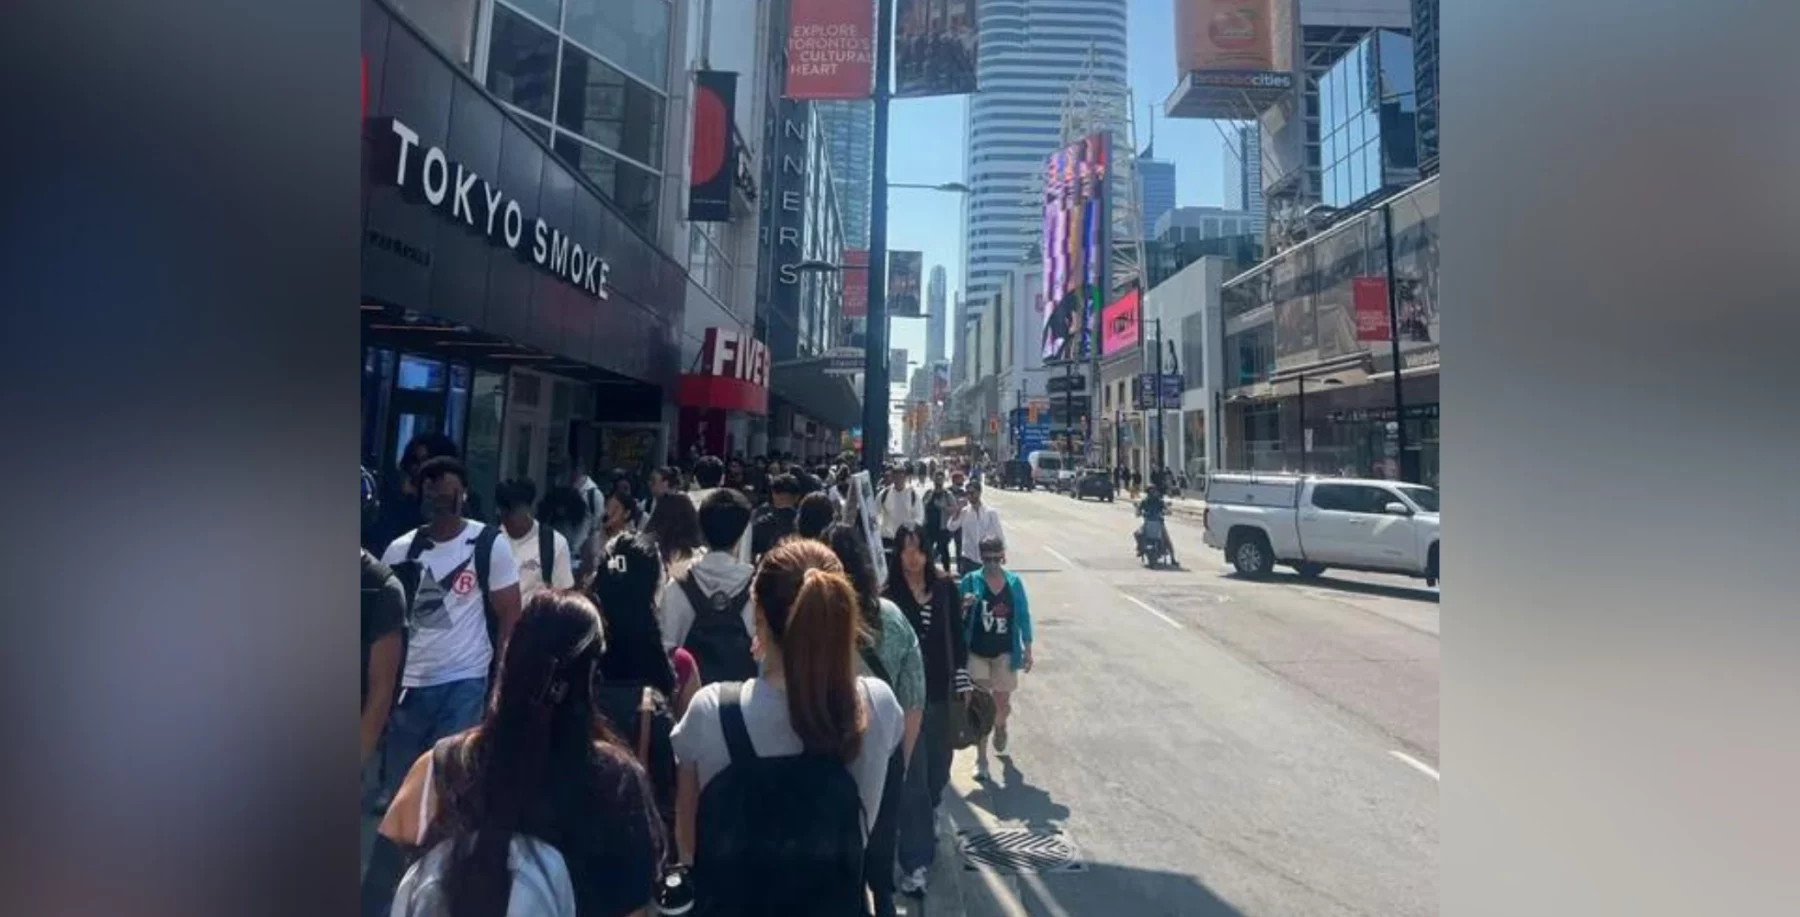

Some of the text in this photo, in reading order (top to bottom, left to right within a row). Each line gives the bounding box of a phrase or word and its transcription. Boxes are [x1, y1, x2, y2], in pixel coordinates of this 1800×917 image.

[793, 23, 857, 37] EXPLORE
[790, 63, 838, 76] HEART
[799, 50, 873, 63] CULTURAL
[392, 118, 610, 300] TOKYO SMOKE
[779, 118, 805, 285] NNERS
[711, 327, 765, 386] FIVE
